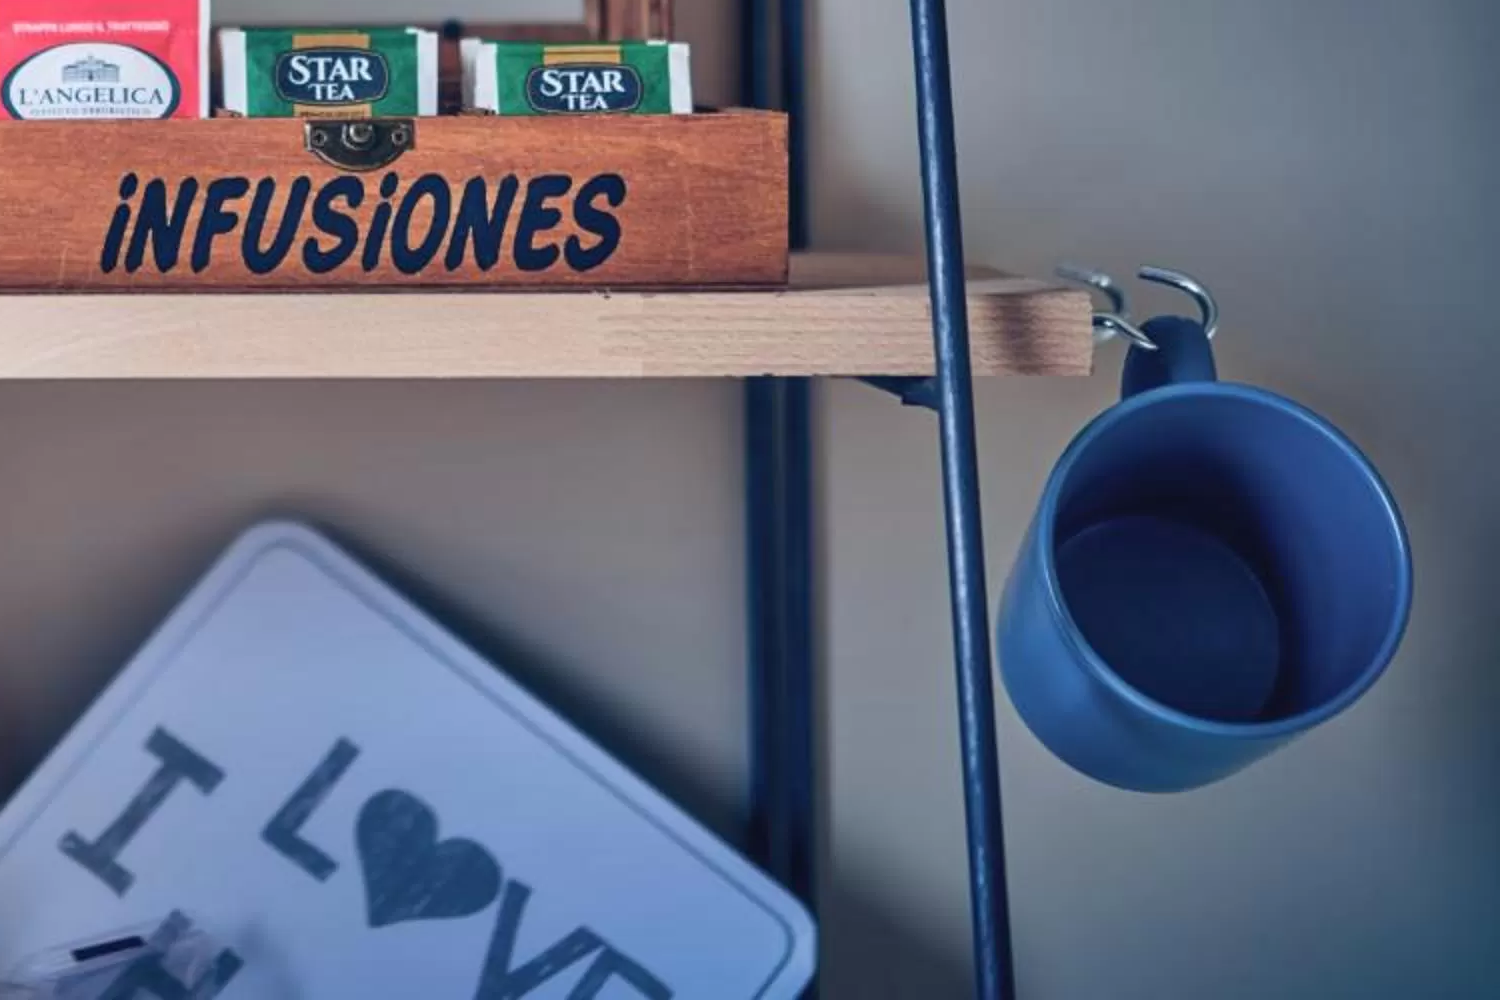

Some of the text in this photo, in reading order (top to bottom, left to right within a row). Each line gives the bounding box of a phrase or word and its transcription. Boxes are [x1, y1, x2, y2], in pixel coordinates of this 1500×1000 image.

[288, 55, 372, 84] STAR
[308, 83, 355, 100] TEA
[540, 69, 626, 96] STAR
[18, 87, 165, 105] L'ANGELICA
[560, 94, 609, 110] TEA
[56, 724, 227, 898] I
